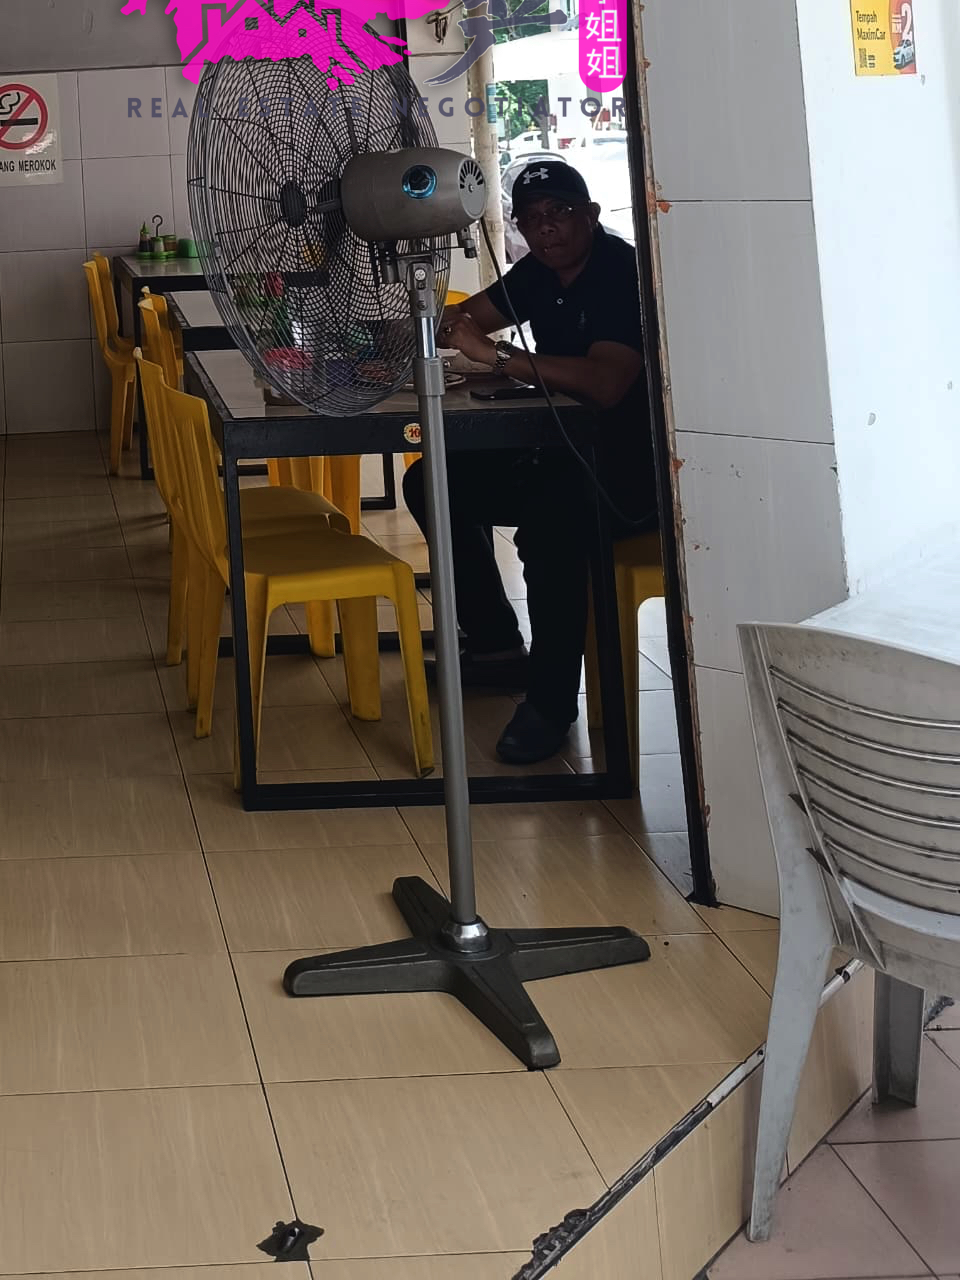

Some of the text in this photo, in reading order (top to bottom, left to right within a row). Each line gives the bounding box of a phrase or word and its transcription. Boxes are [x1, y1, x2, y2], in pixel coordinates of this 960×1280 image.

[855, 10, 878, 24] Tempah
[857, 27, 886, 41] MaximCar
[18, 159, 57, 172] MEROKOK
